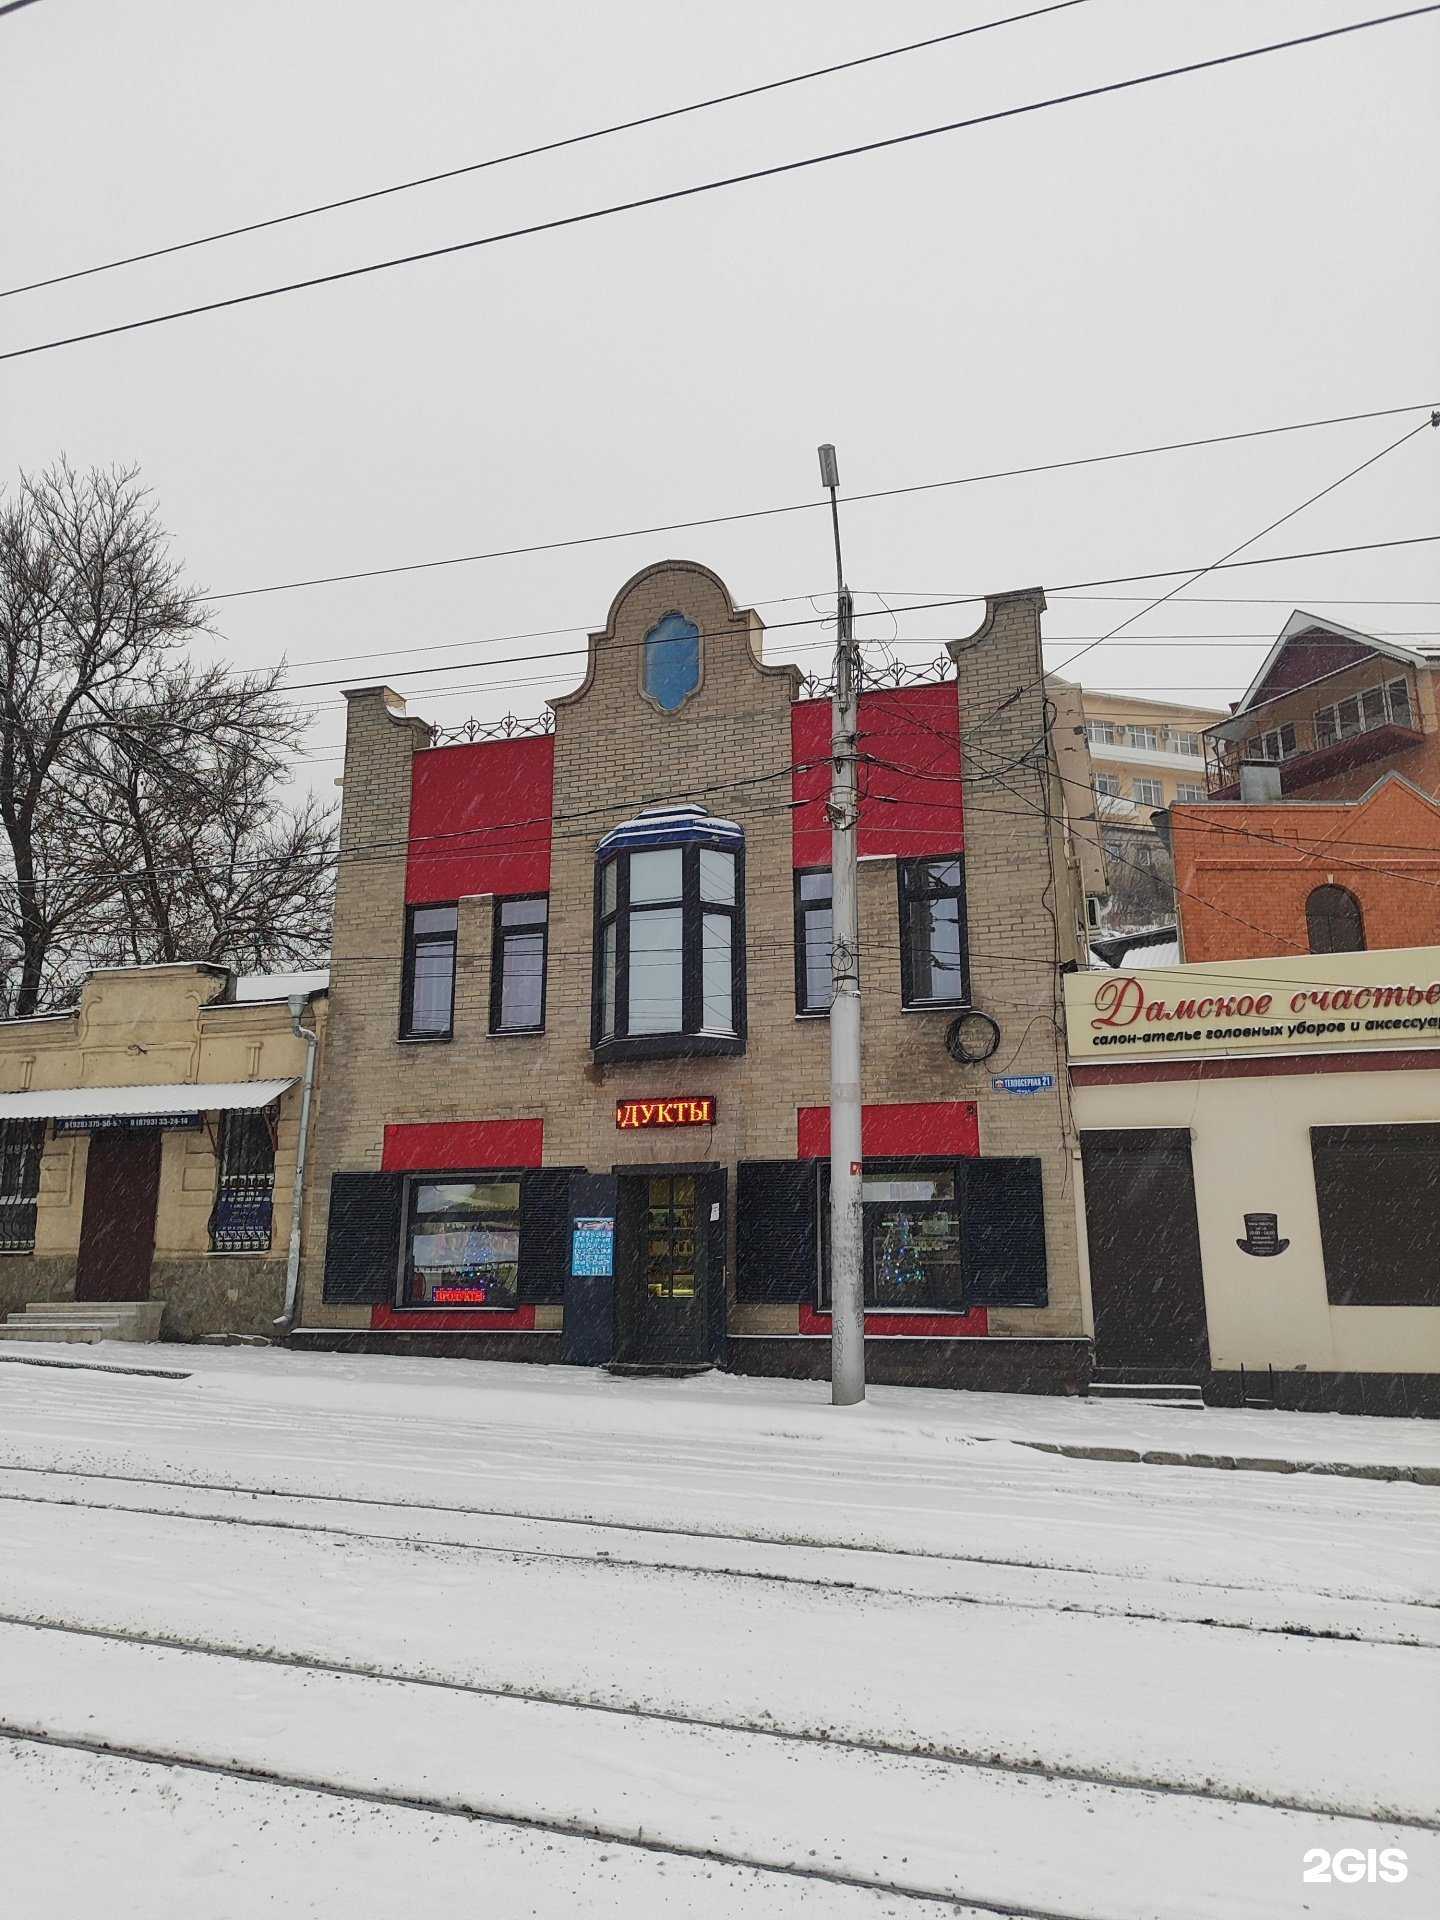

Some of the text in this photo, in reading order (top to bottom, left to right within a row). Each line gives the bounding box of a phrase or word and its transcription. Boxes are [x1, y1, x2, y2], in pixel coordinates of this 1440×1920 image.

[1091, 977, 1440, 1029] Дамское счастье
[1092, 1026, 1202, 1046] салон-ателье
[1205, 1024, 1283, 1040] головных
[1287, 1020, 1346, 1039] уборов
[1350, 1019, 1361, 1032] и
[1041, 1076, 1050, 1086] 21
